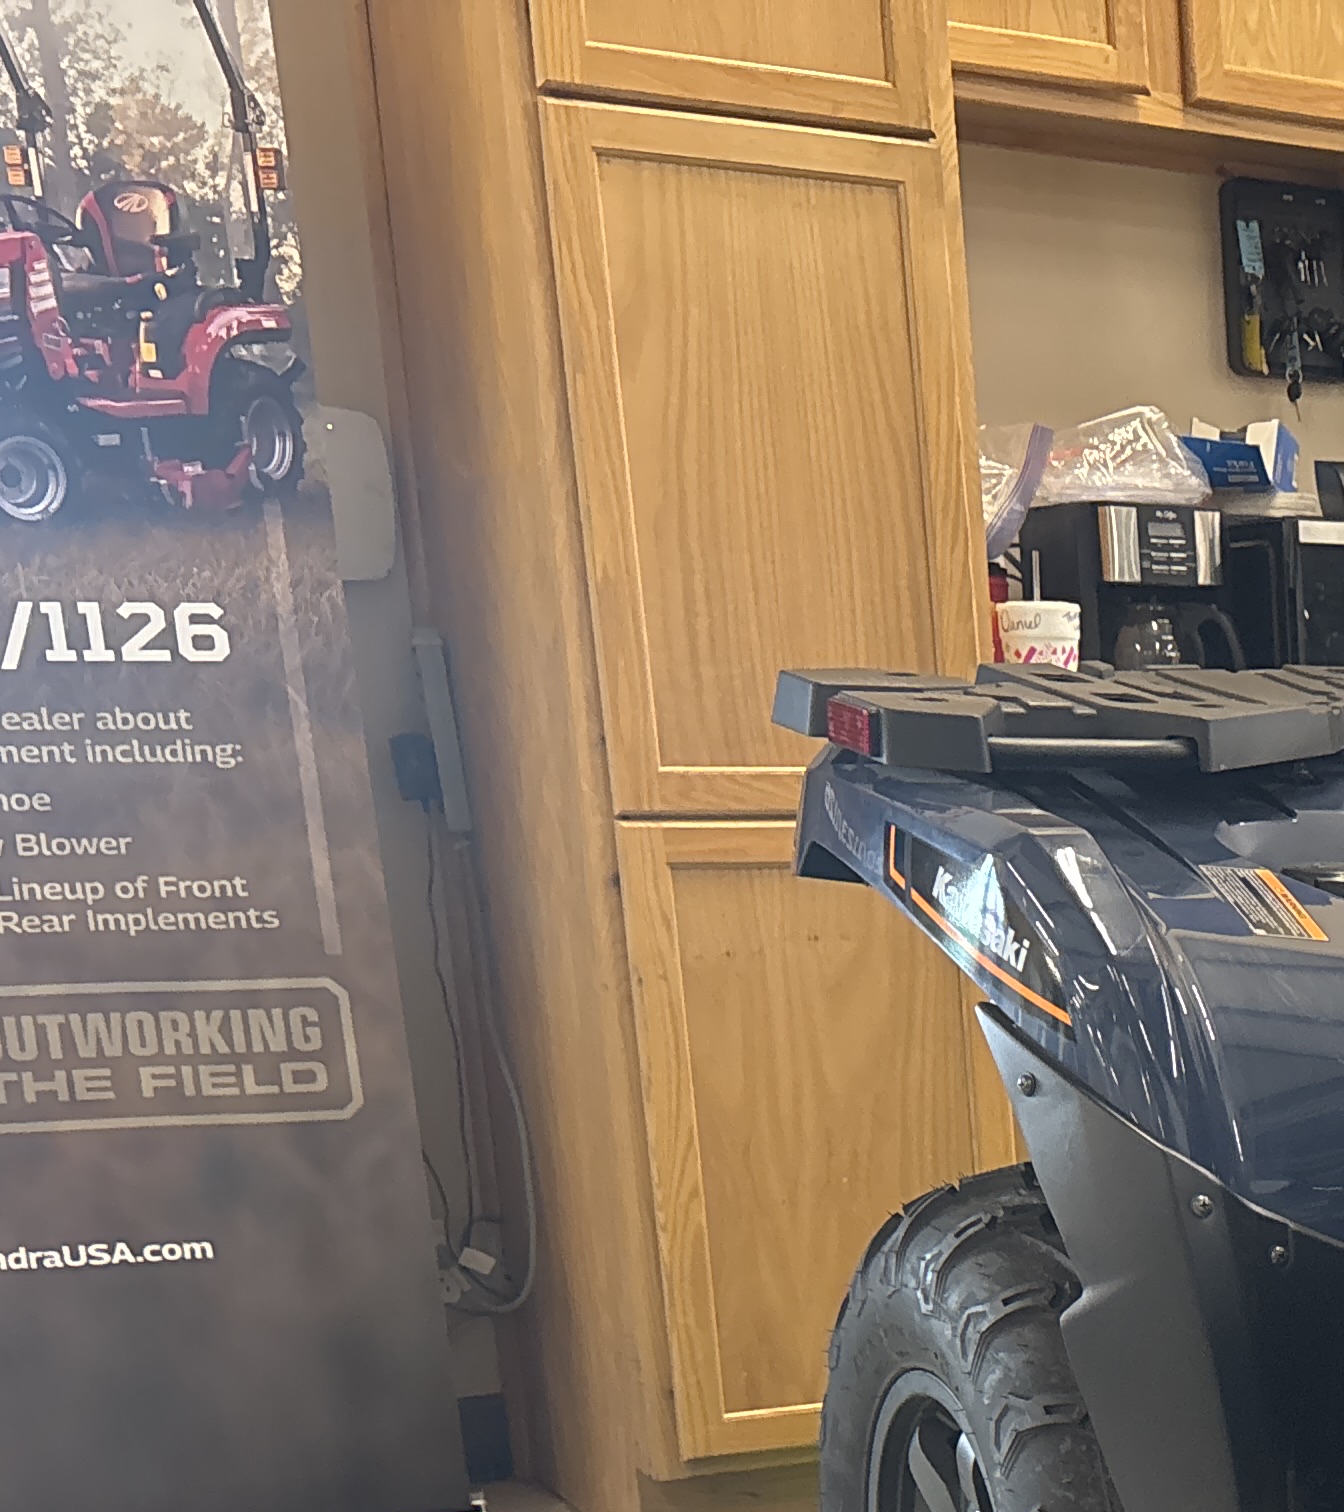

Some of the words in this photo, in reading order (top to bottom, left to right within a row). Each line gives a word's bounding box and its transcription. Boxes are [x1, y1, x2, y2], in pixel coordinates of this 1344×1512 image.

[1, 601, 232, 671] /1126
[96, 706, 194, 732] about
[84, 738, 245, 770] including:
[15, 832, 133, 857] Blower
[114, 875, 150, 901] of
[157, 875, 250, 900] Front
[87, 906, 282, 938] Implements
[931, 865, 1031, 973] Kasaki
[0, 1005, 324, 1063] UTWORKING
[138, 1060, 329, 1099] FIELD
